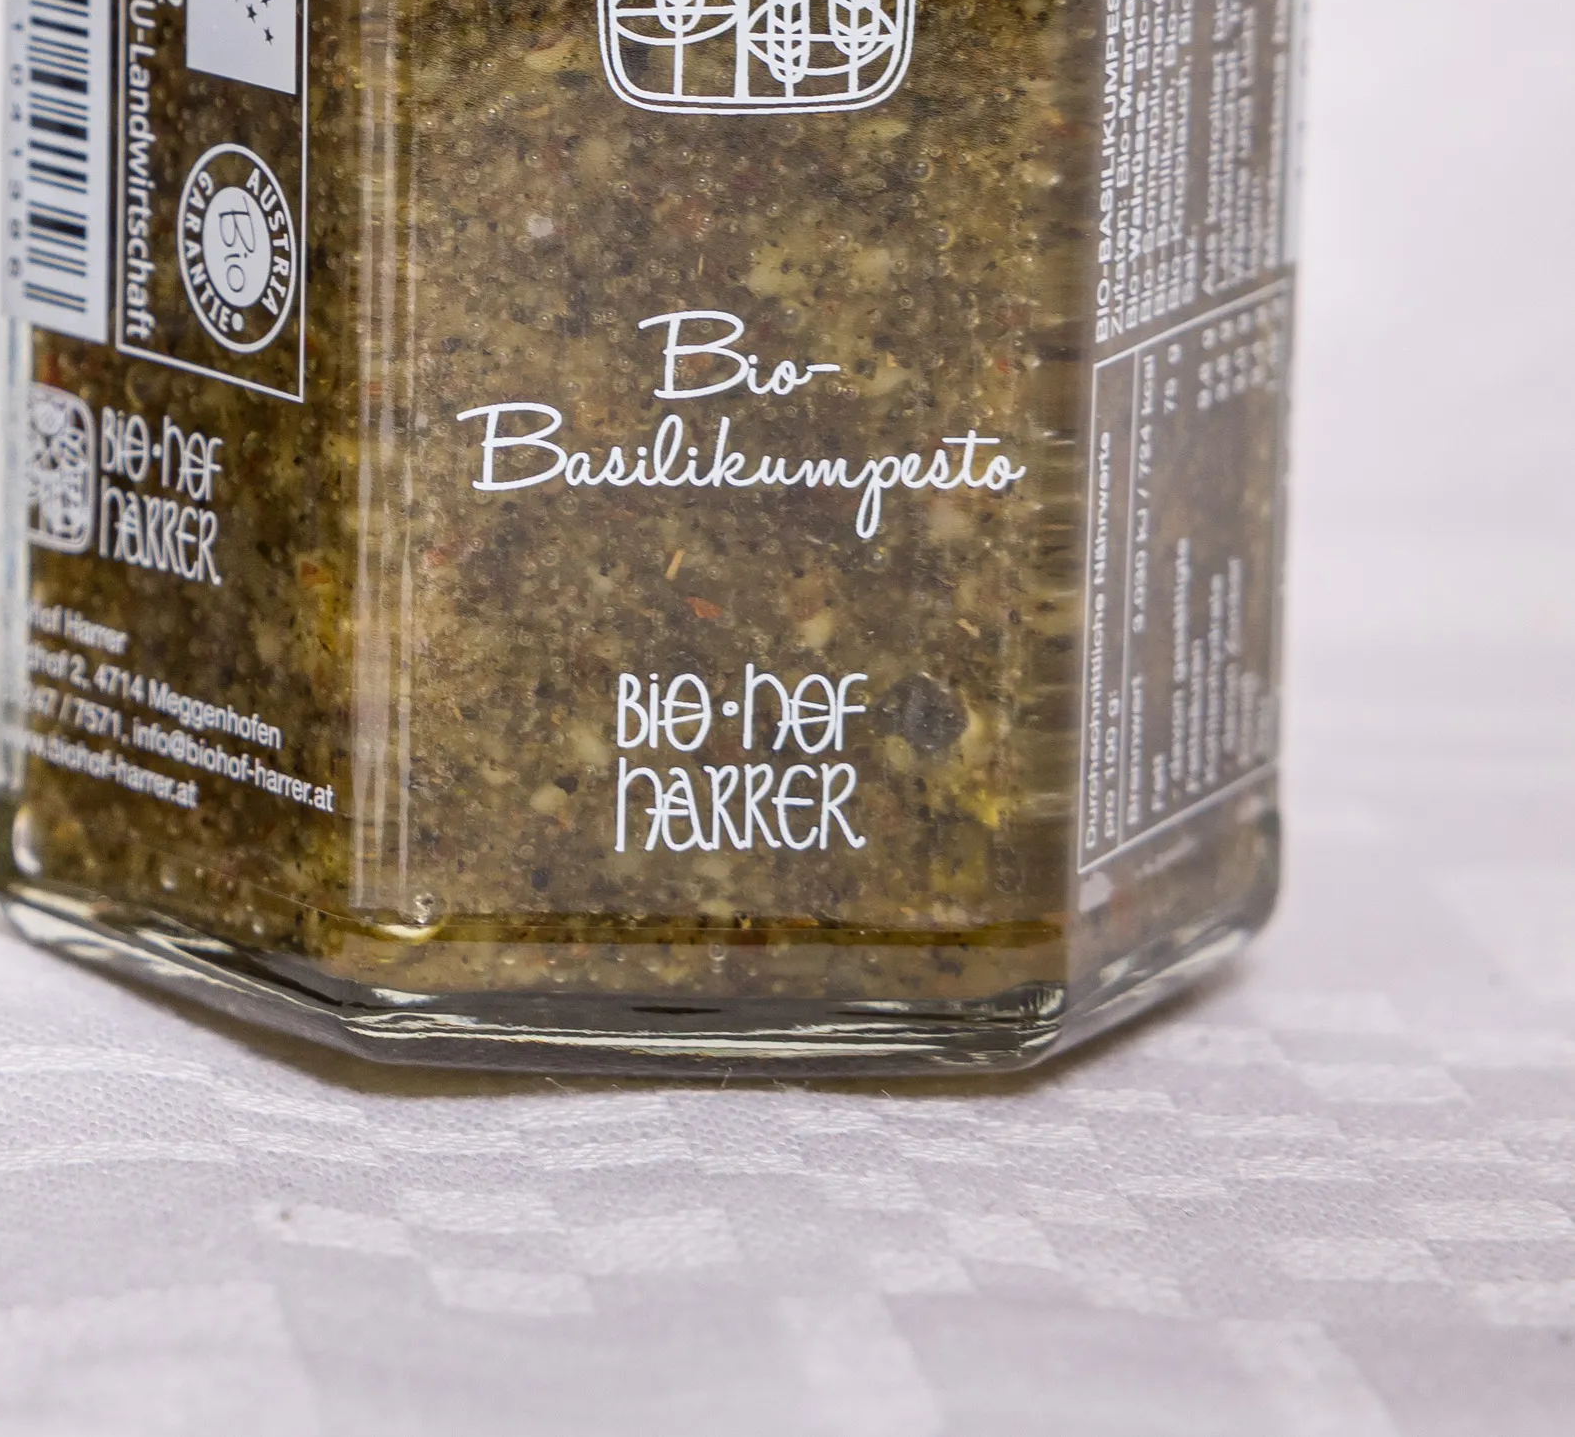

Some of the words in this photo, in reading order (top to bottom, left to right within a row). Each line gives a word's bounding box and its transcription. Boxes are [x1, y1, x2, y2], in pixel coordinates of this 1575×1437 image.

[217, 196, 254, 294] Bio
[246, 168, 291, 317] AUSTRIA
[1111, 199, 1130, 335] Zutaten:
[638, 309, 841, 399] Bio-
[456, 402, 1026, 539] Basilikumpesto
[1092, 432, 1111, 585] Nährwerte
[99, 475, 222, 586] HARRER
[74, 694, 129, 746] 7571,
[132, 715, 334, 813] info@biohof-harrer.at
[94, 662, 146, 704] 4714
[148, 678, 282, 750] Meggenhofen
[1085, 593, 1106, 848] Durchschnittliche
[615, 757, 867, 853] HARRER
